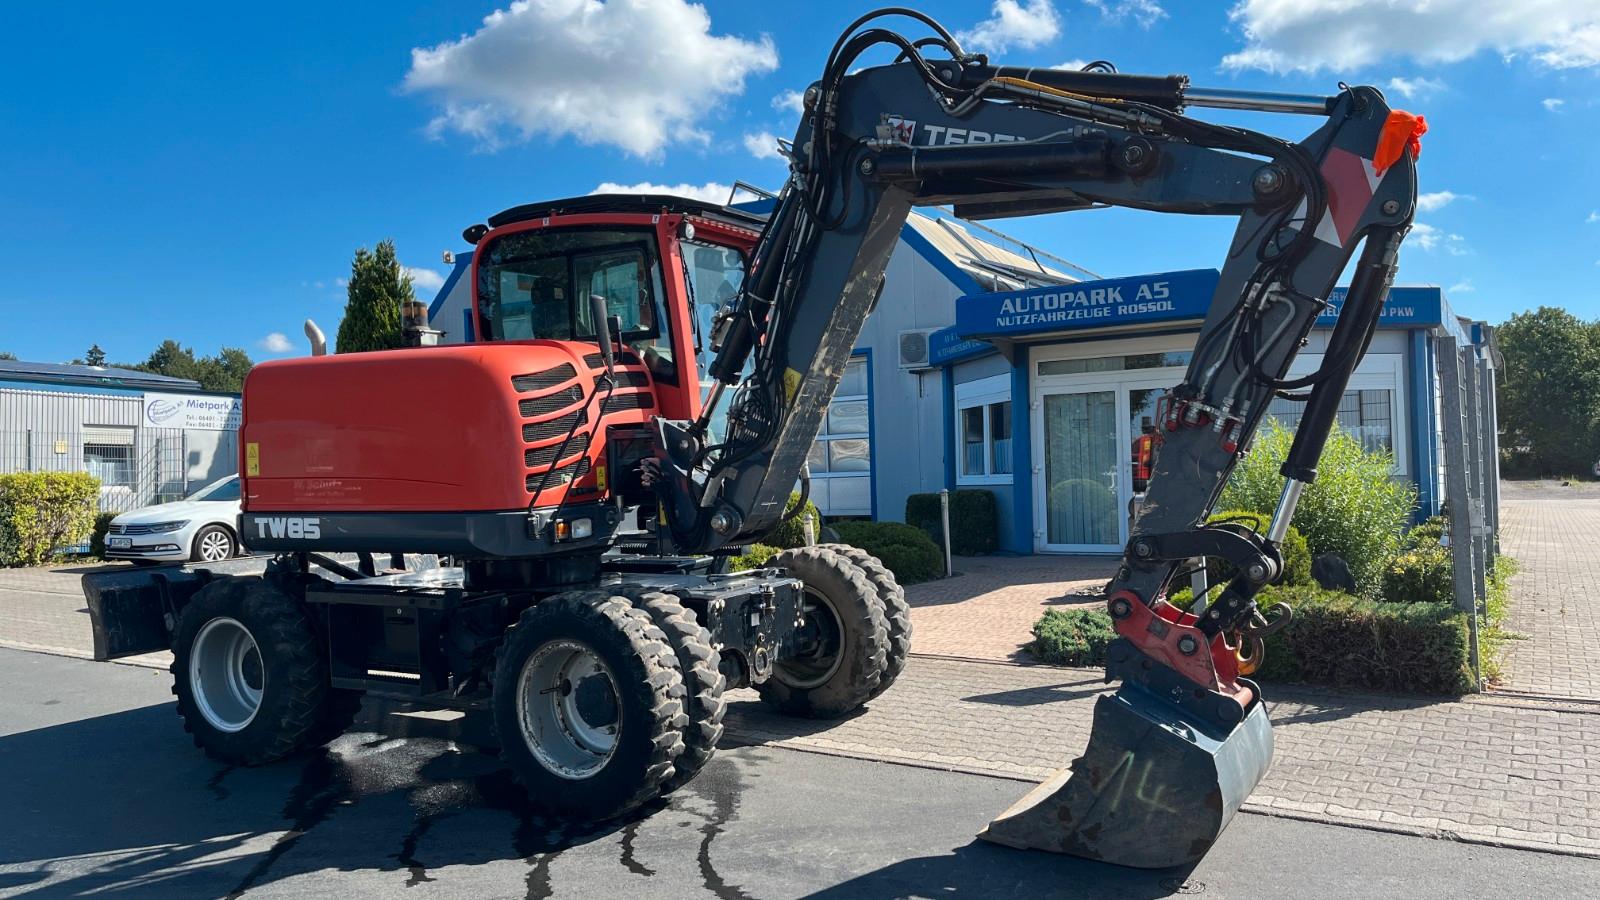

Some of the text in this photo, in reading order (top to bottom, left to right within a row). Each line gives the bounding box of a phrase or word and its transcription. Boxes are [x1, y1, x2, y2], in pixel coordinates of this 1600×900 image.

[924, 124, 1026, 146] TER
[999, 281, 1169, 315] AUTOPARK A5
[996, 300, 1176, 327] NUTZFAHRZEUGE ROSSOL
[1389, 306, 1415, 317] PKW
[186, 399, 229, 411] Mietpark
[254, 517, 320, 540] TW85
